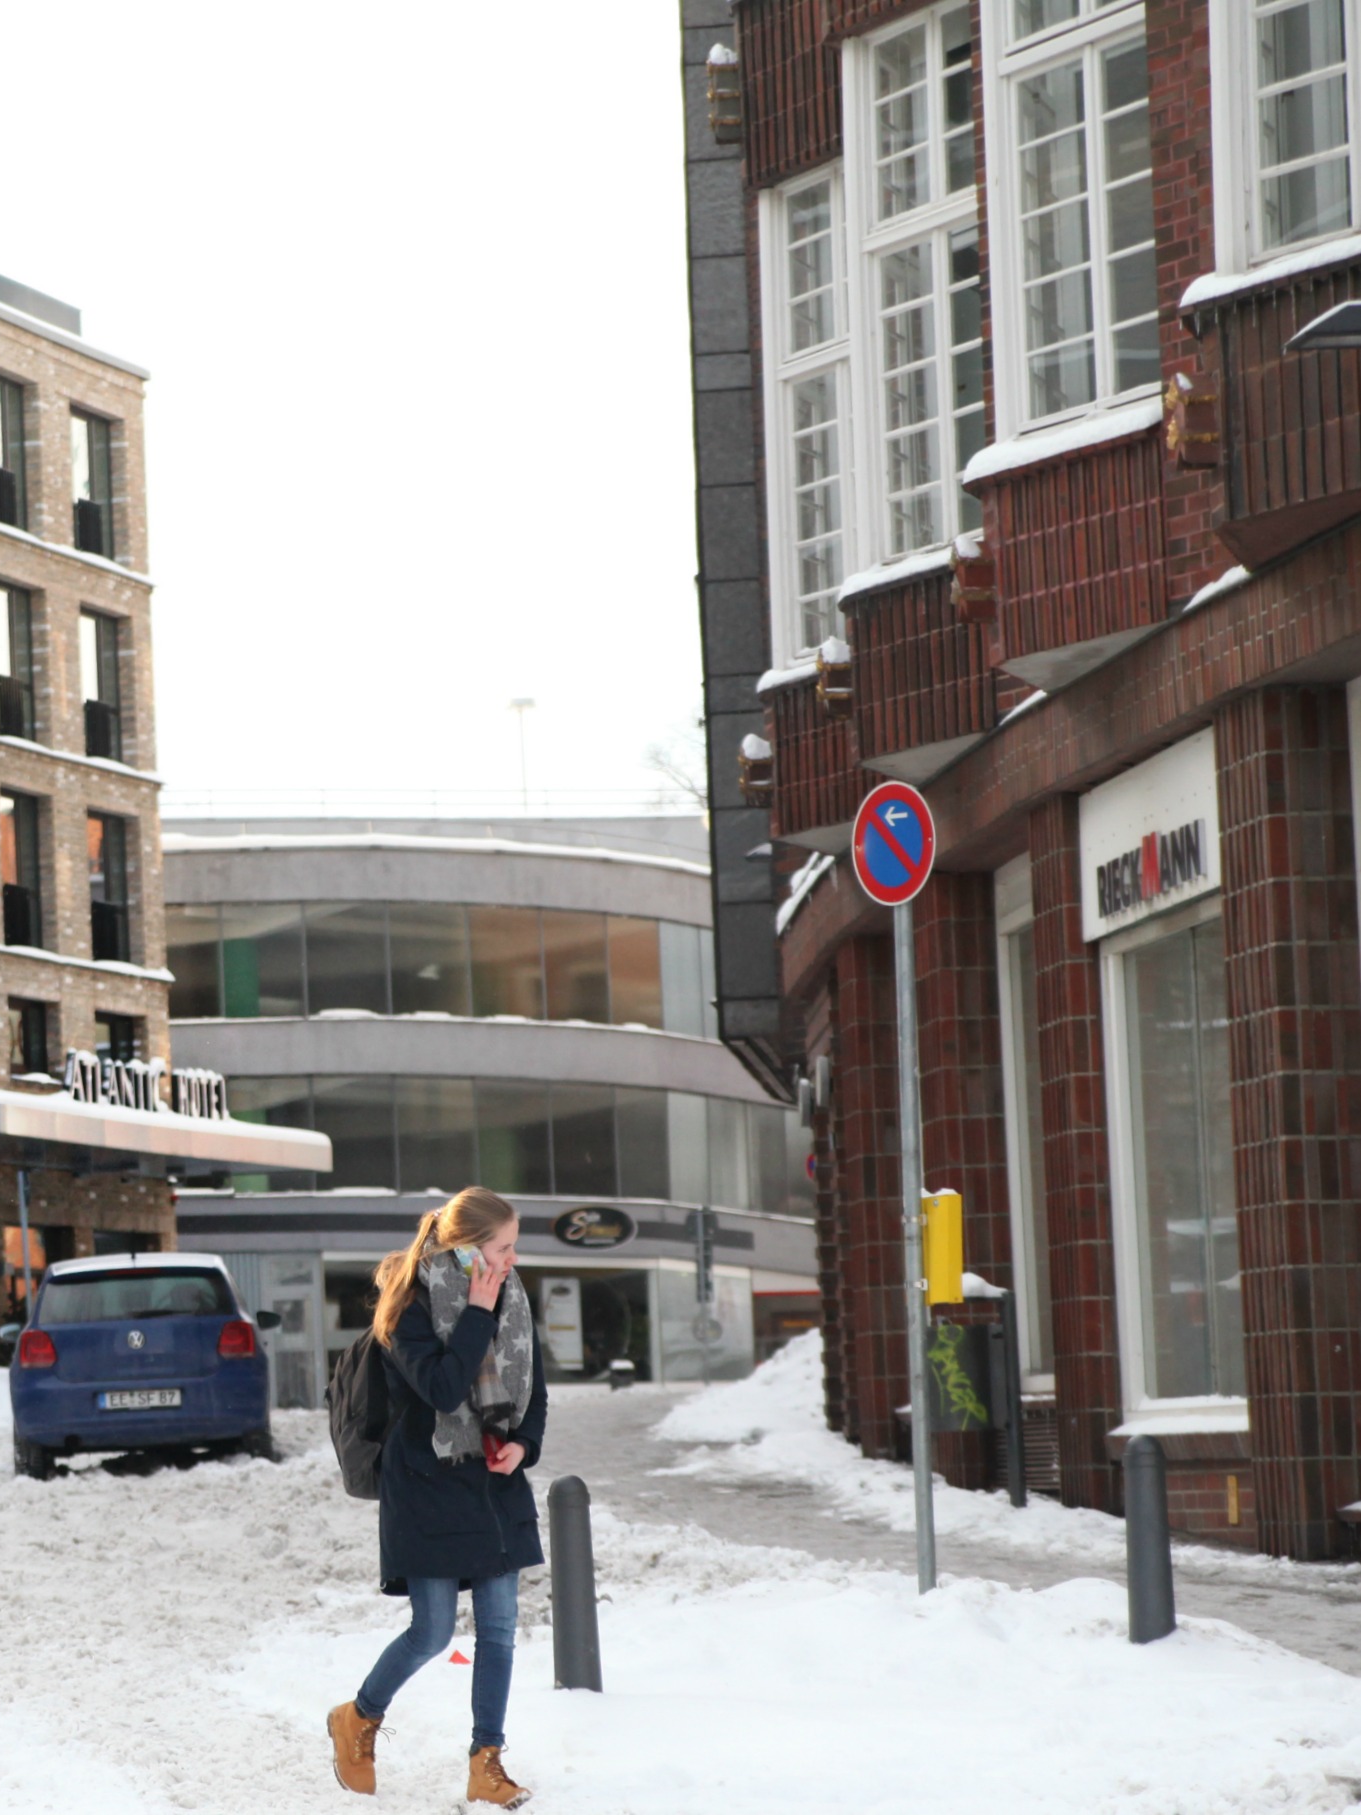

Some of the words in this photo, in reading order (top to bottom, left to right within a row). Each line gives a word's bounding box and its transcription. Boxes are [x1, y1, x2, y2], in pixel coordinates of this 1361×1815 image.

[1097, 820, 1203, 918] RIECKMANN
[67, 1051, 168, 1112] ATLANTIC
[174, 1070, 227, 1120] HOTEL
